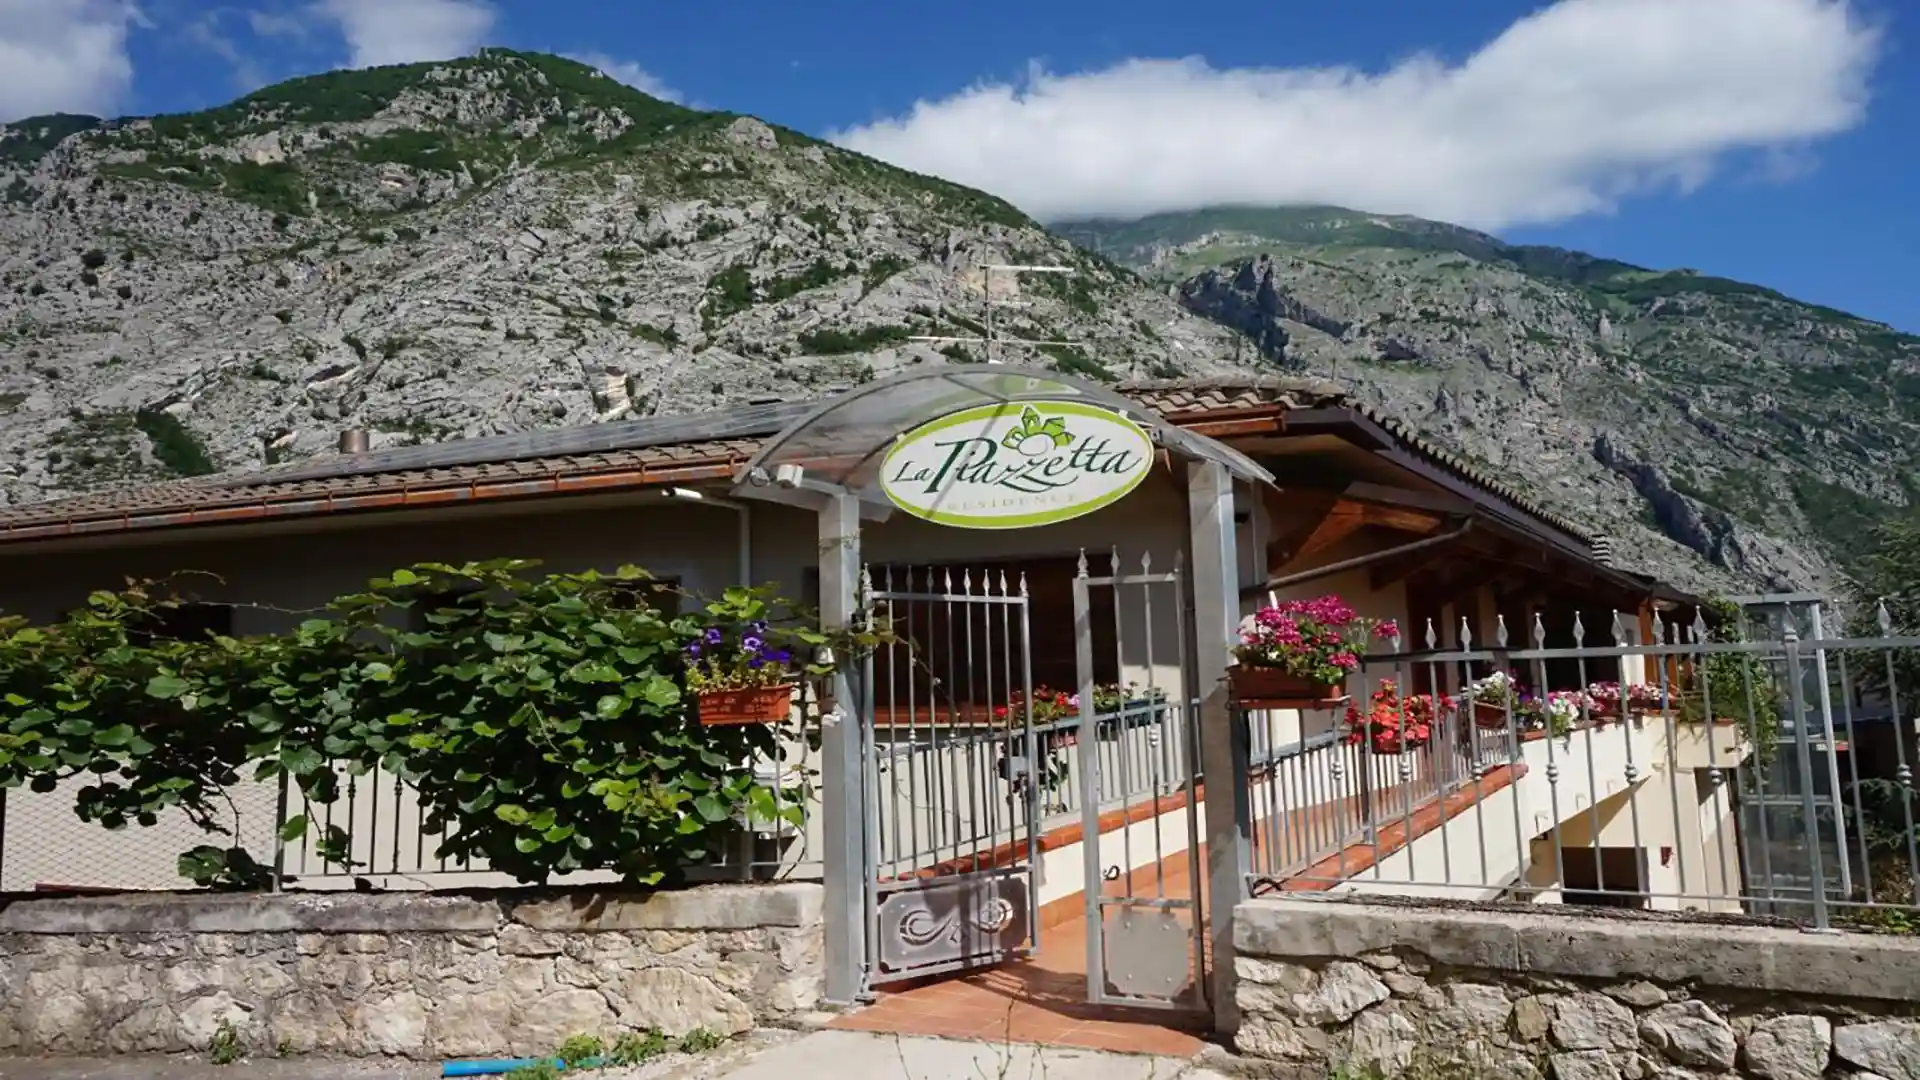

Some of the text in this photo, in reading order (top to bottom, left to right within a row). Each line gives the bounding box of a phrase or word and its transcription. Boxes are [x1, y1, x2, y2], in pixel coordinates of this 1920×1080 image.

[890, 434, 1143, 494] La Piazzetta
[946, 493, 1077, 511] RESIDENCE
